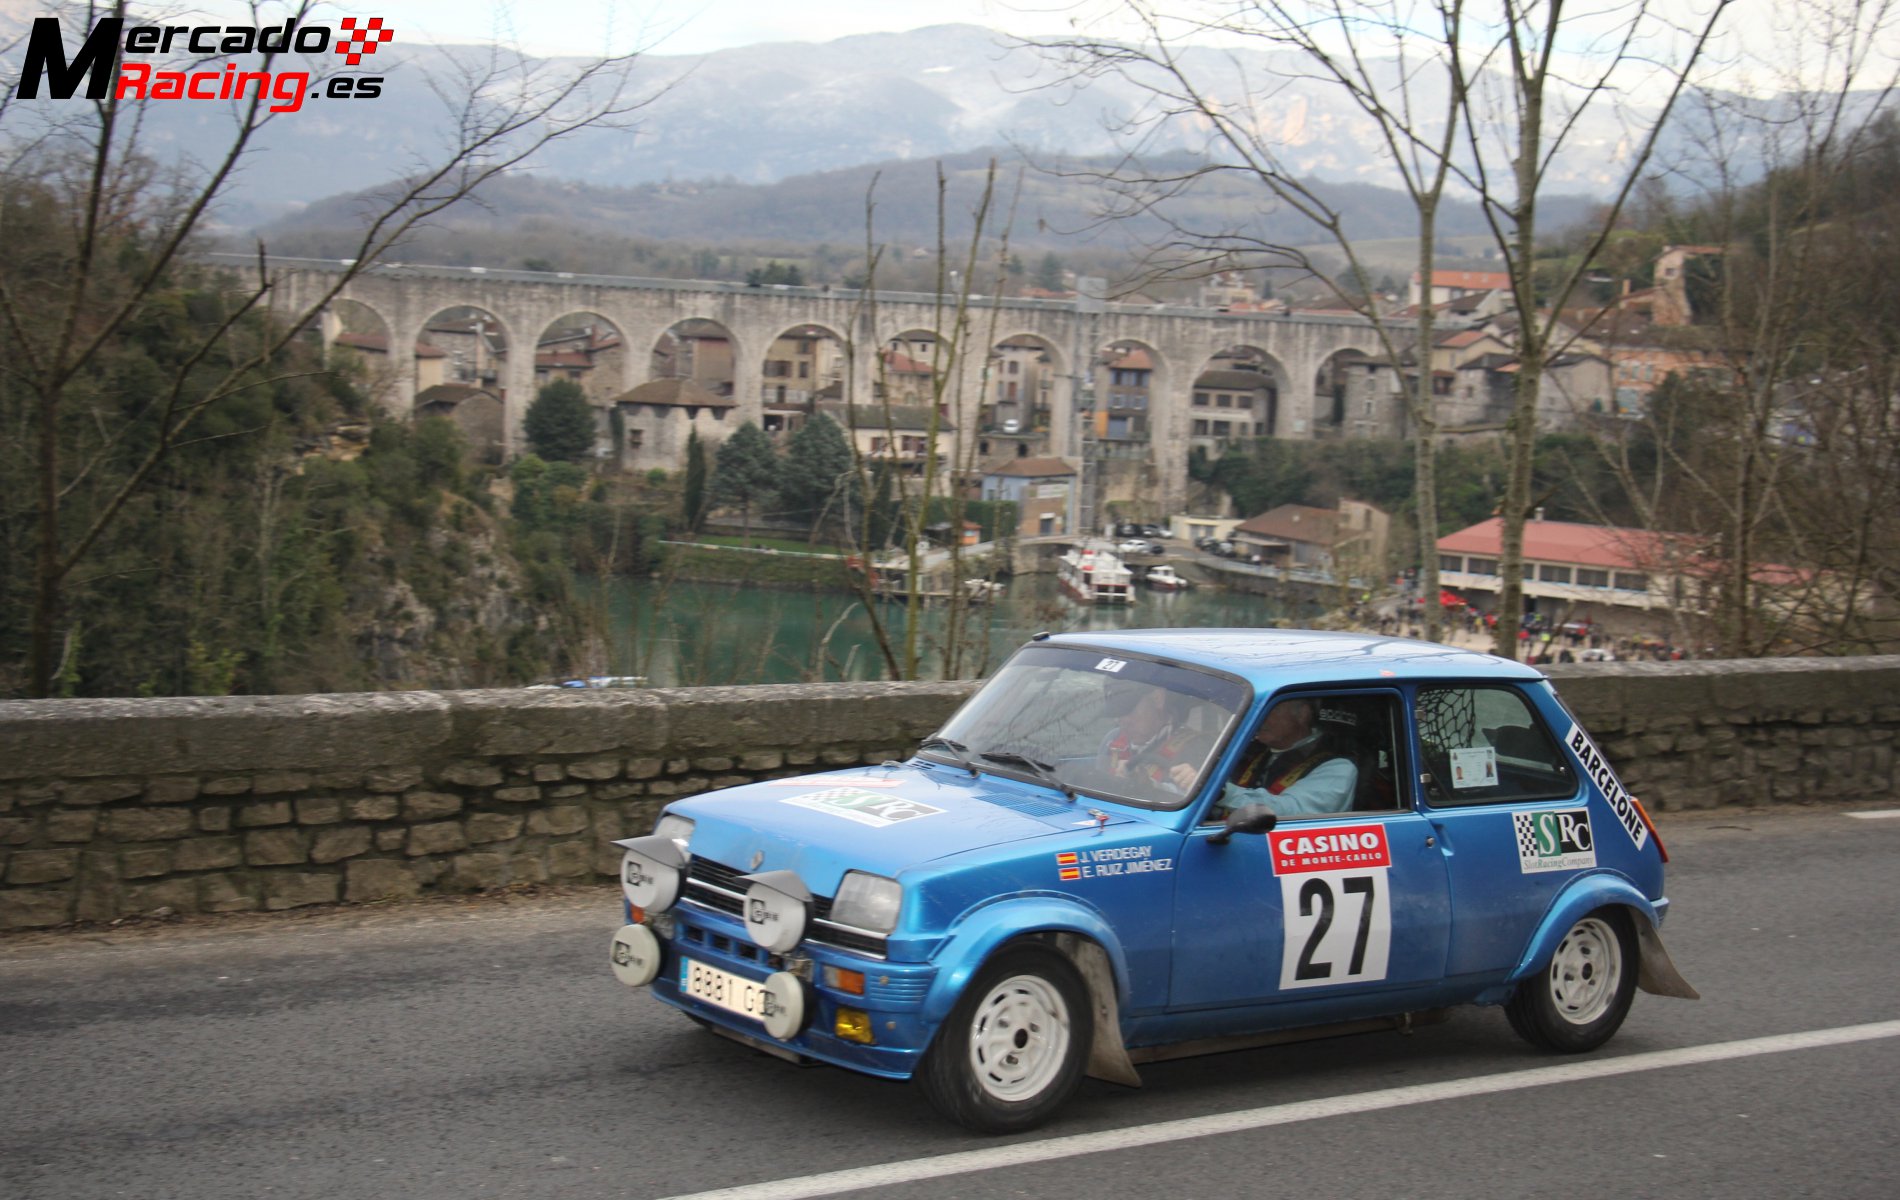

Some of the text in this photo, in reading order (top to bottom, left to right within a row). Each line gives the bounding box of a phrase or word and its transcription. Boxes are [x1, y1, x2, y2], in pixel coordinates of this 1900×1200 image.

[1571, 730, 1643, 842] BARCELONE
[828, 796, 924, 821] SRC
[1278, 832, 1379, 856] CASINO
[1540, 813, 1591, 855] SRC
[1090, 845, 1152, 862] VERDEGAY
[1281, 852, 1382, 867] DE MONTE-CARLO
[1096, 863, 1124, 877] RUIZ
[1295, 876, 1375, 981] 27
